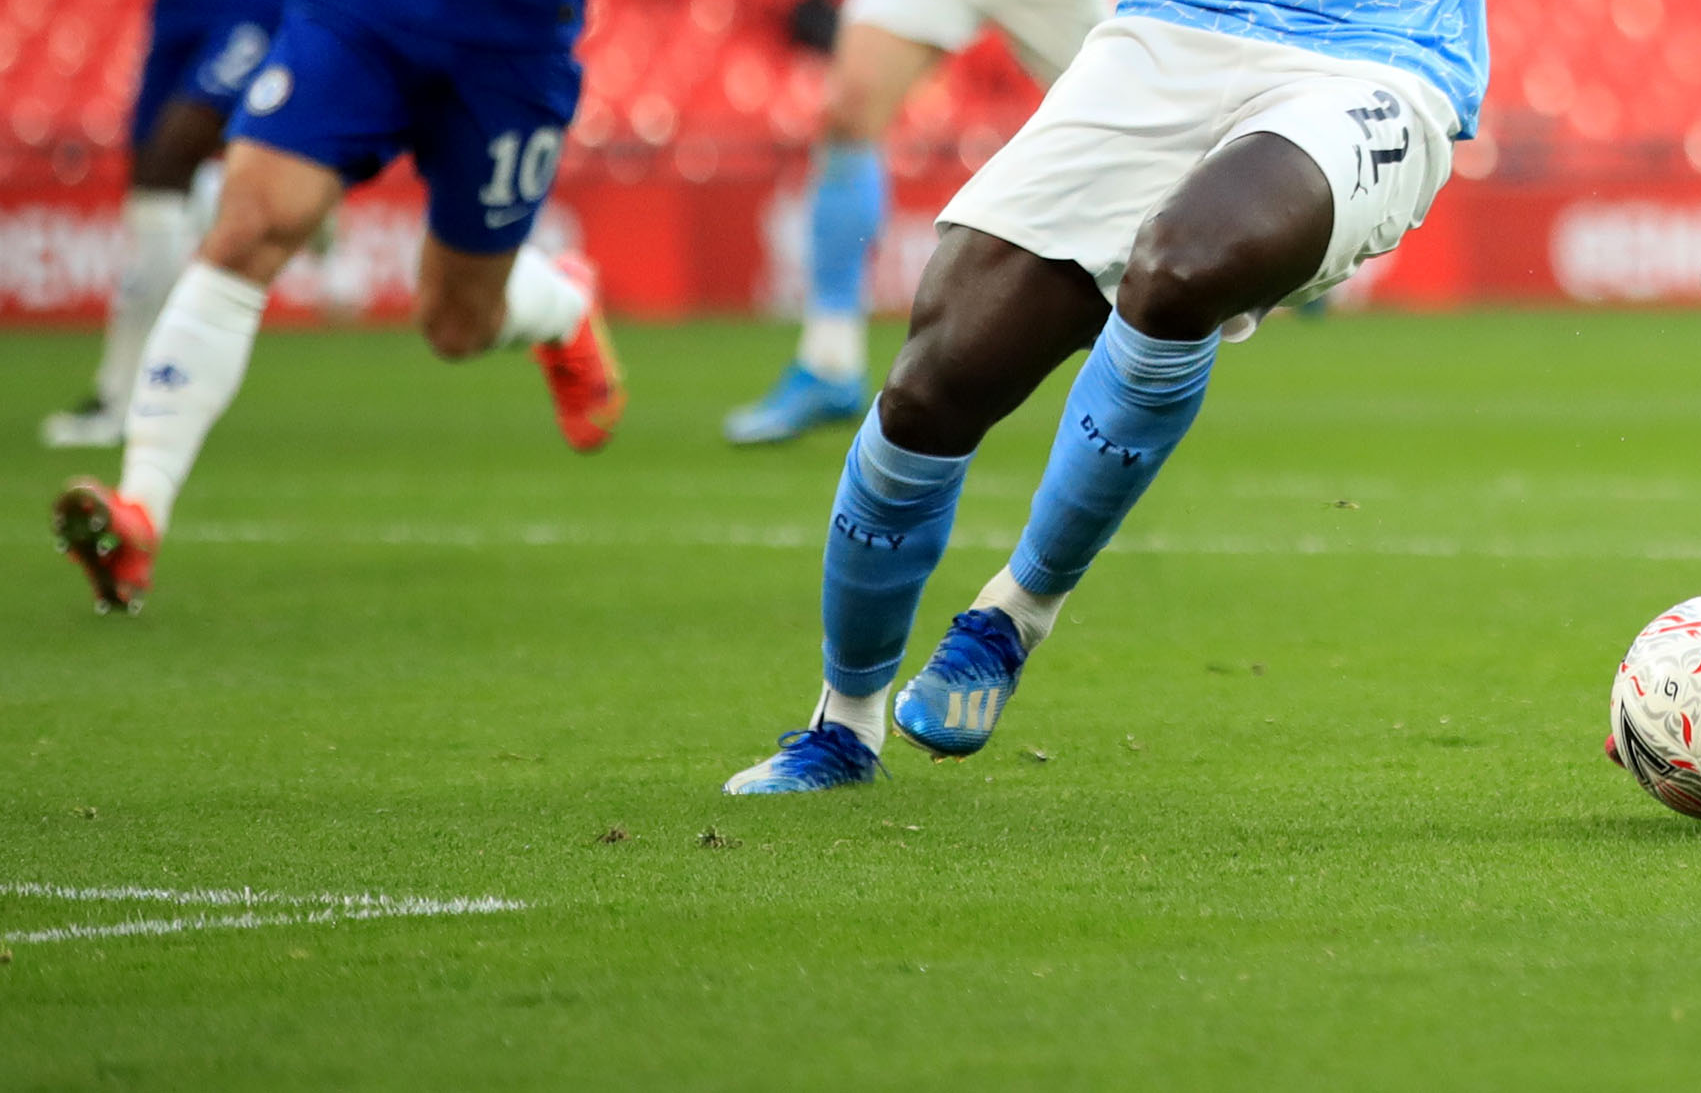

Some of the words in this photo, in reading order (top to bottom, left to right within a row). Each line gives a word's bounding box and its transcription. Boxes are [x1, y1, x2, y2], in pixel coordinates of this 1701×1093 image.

[479, 126, 563, 205] 10
[1080, 413, 1142, 468] CITY
[835, 513, 905, 551] CITY
